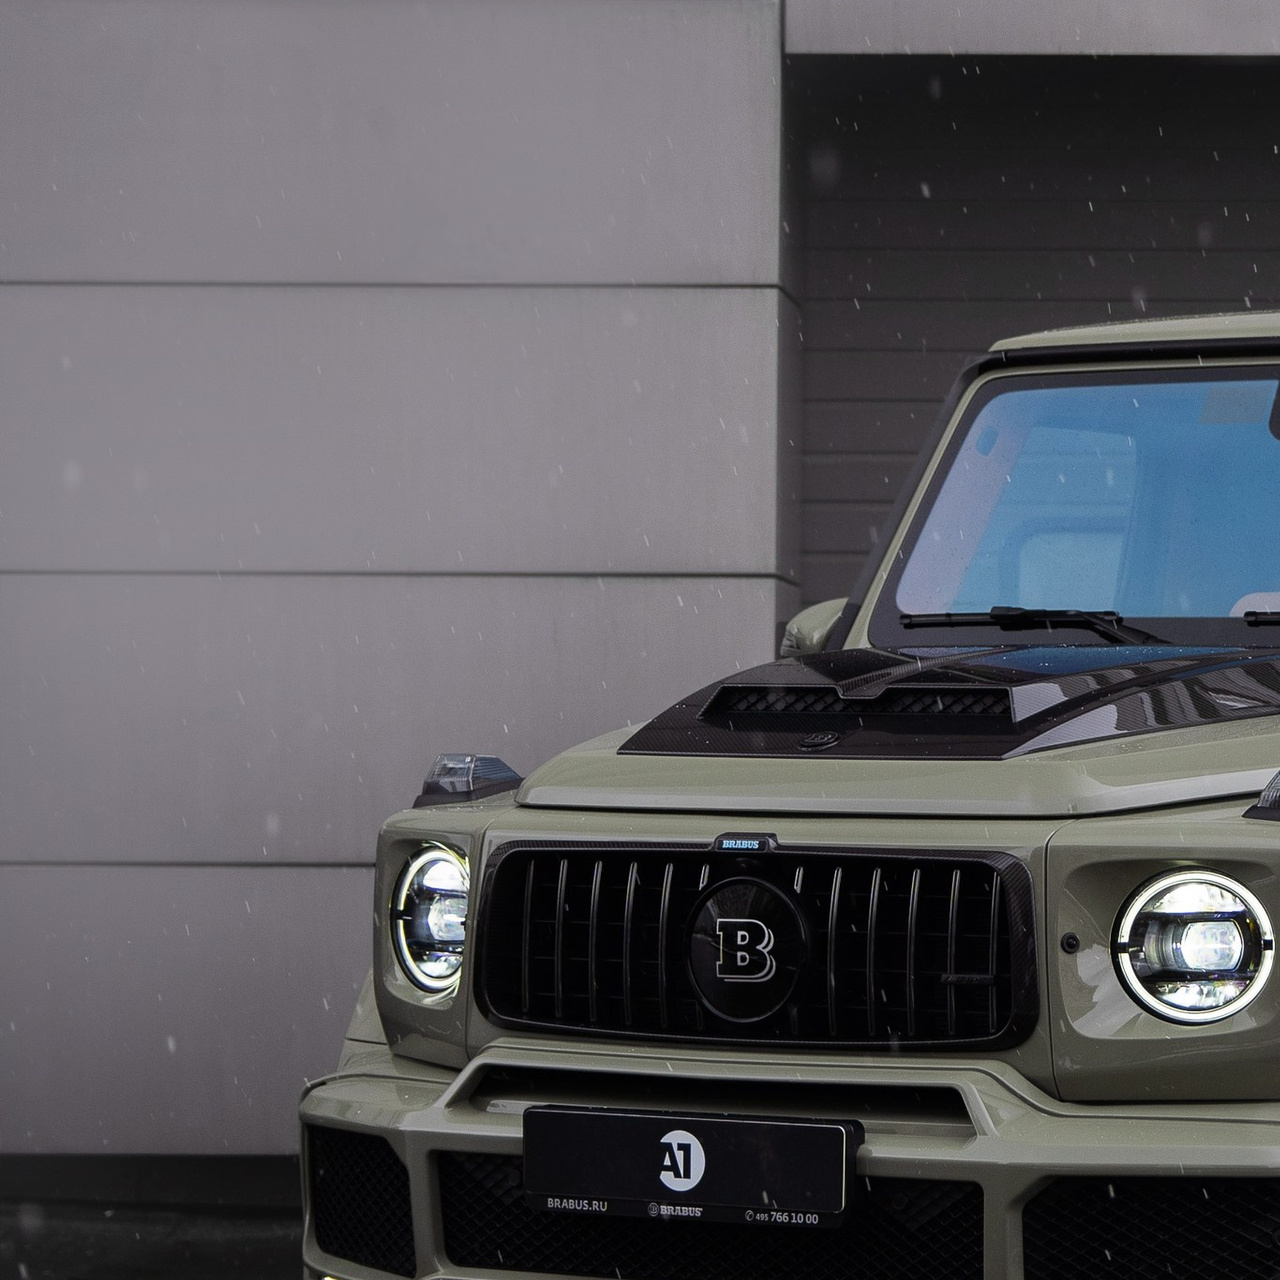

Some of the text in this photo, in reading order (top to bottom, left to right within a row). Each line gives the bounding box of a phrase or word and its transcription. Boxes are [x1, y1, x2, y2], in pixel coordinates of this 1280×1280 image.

[722, 840, 759, 849] BRABUS
[716, 918, 776, 982] B
[547, 1198, 608, 1212] BRABUS.RU
[660, 1205, 703, 1217] BRABUS
[755, 1211, 819, 1224] 495 766 10 00
